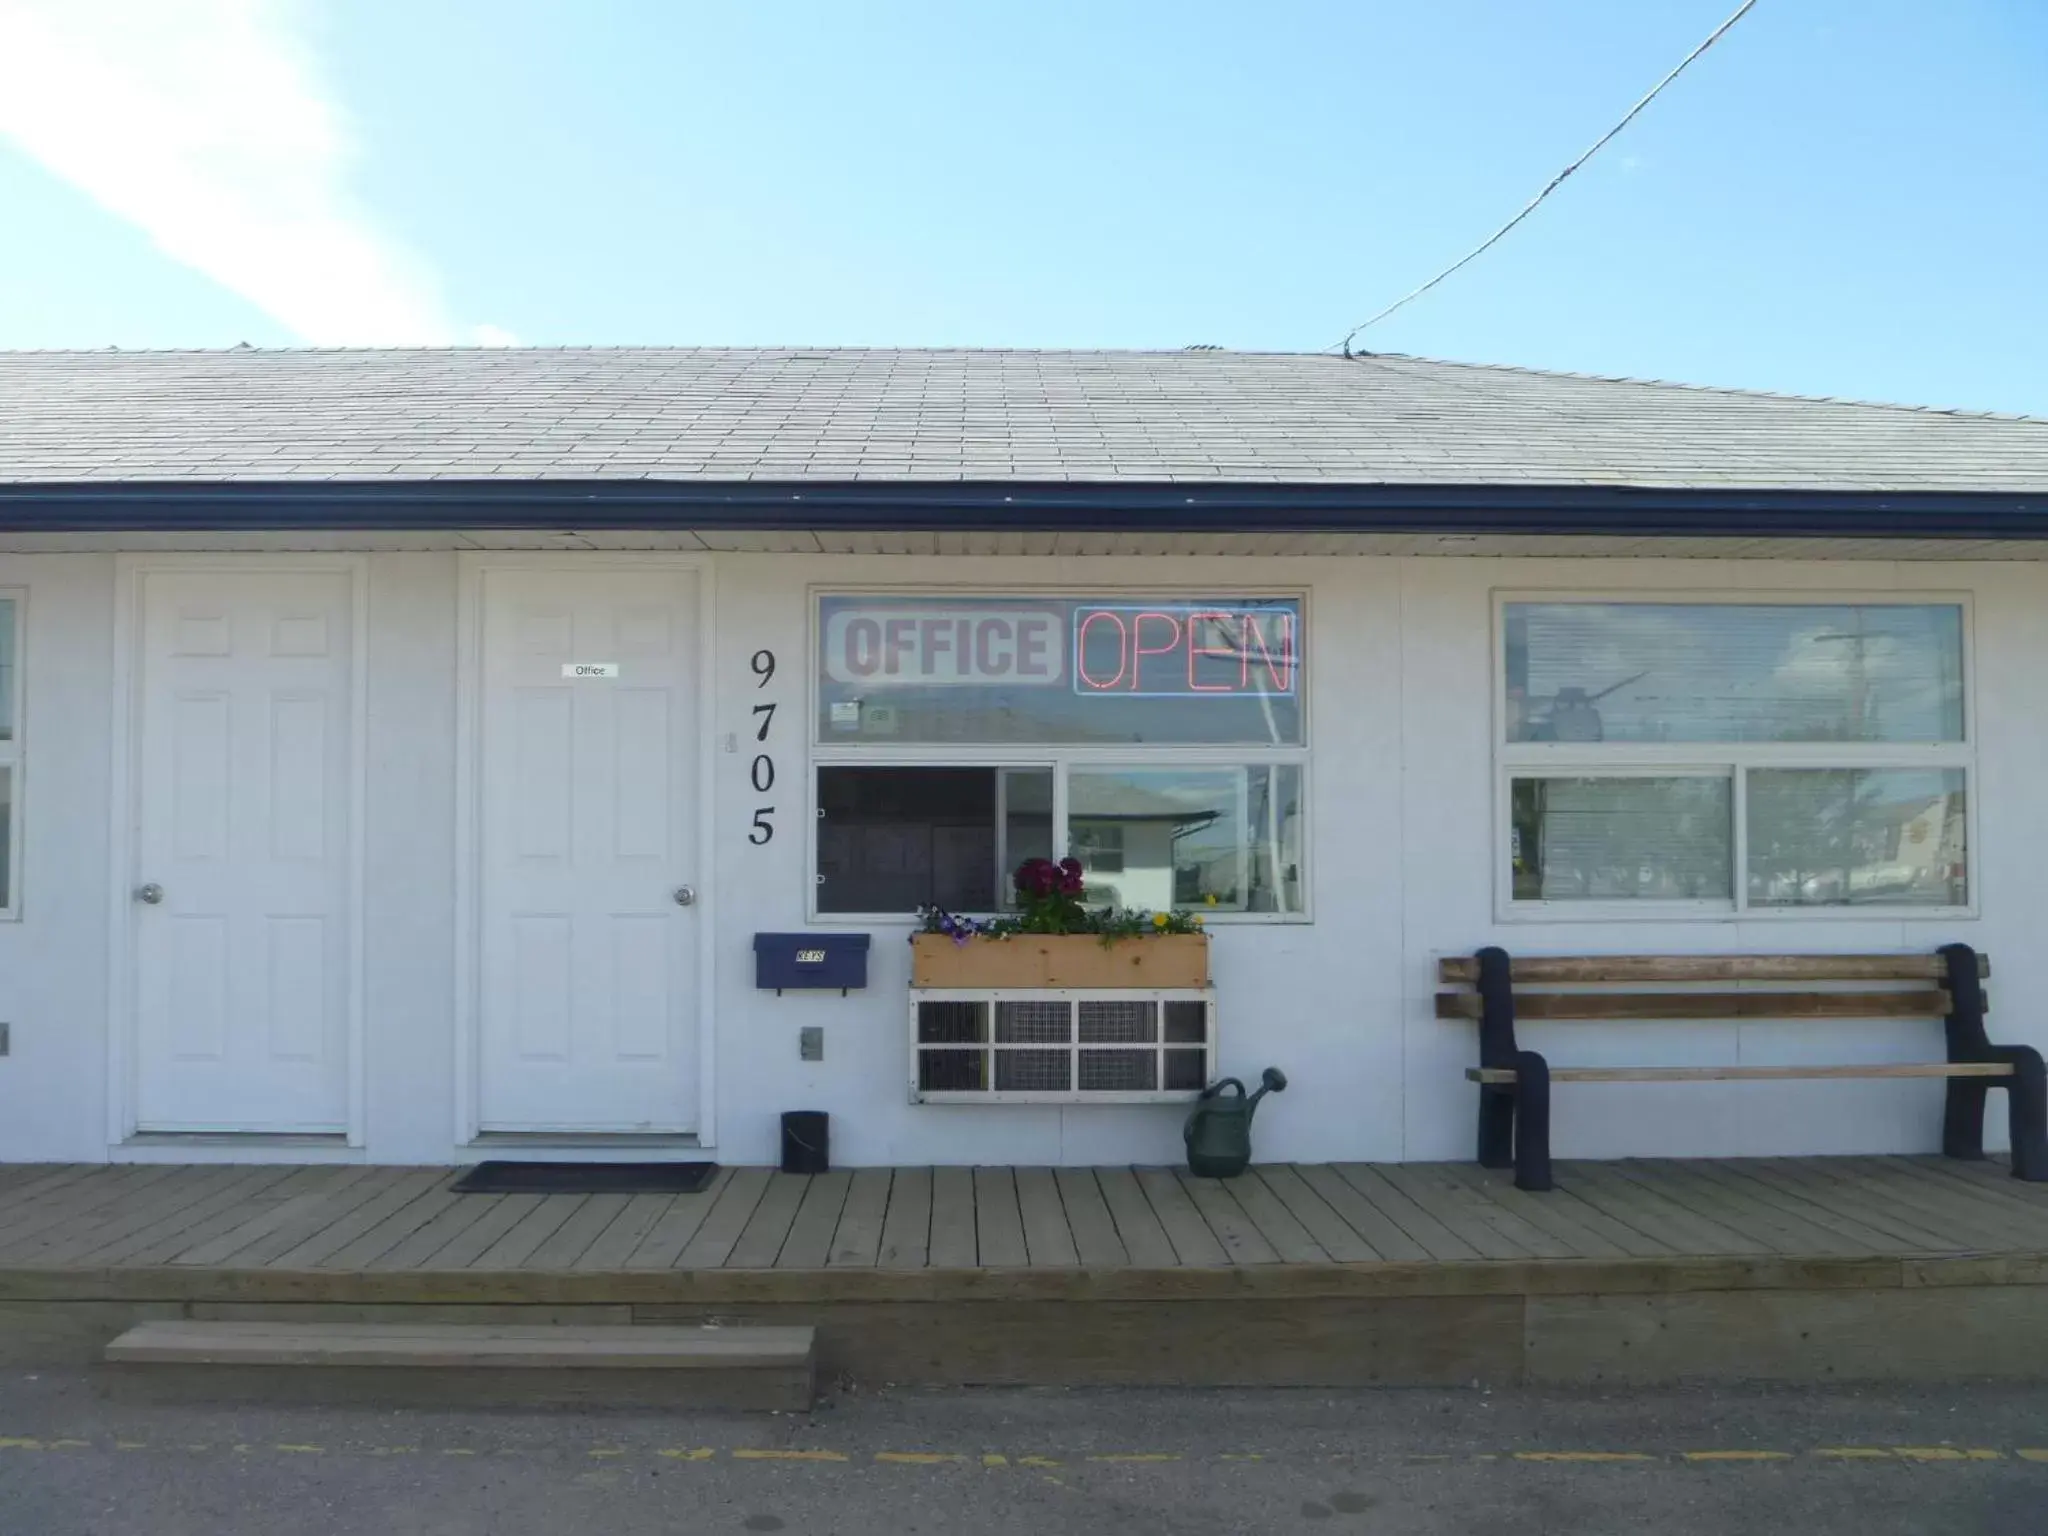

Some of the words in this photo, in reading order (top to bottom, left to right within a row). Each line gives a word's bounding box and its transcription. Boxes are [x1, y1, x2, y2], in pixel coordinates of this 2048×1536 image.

[575, 666, 606, 675] Office
[844, 617, 1048, 676] OFFICE
[1079, 611, 1290, 690] OPEN
[748, 650, 777, 845] 9705
[797, 950, 825, 961] KEYS
